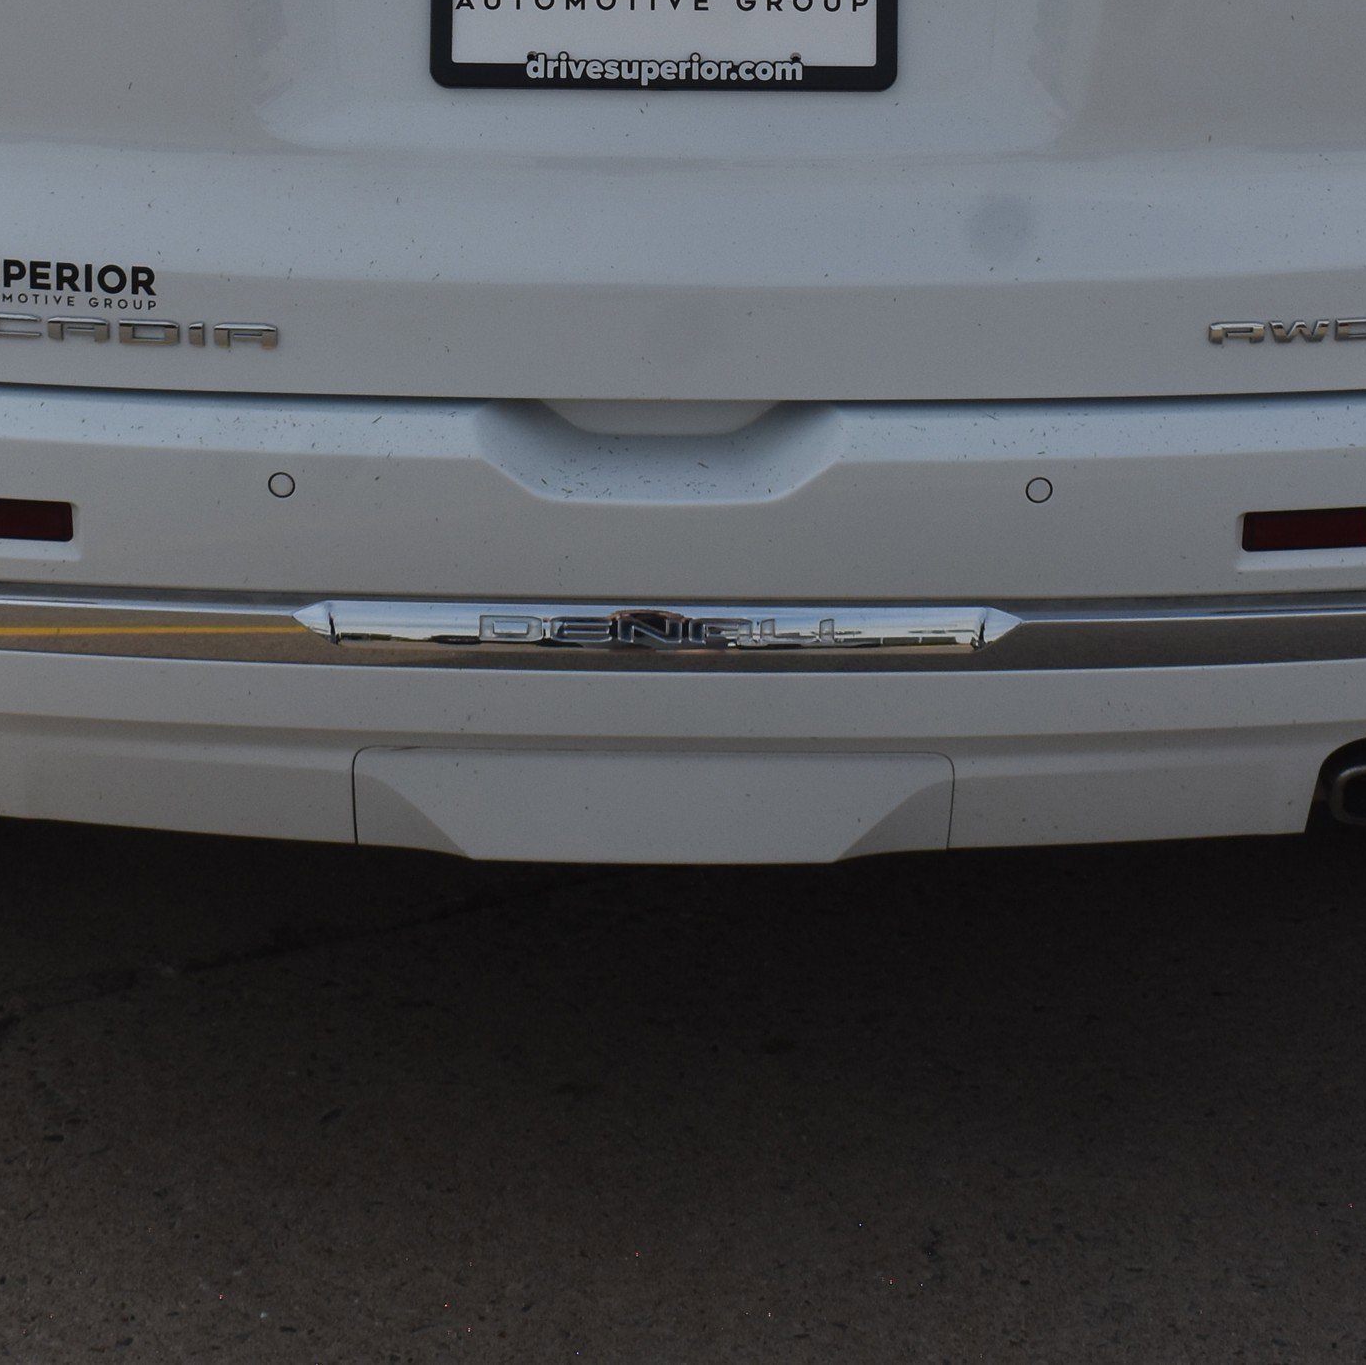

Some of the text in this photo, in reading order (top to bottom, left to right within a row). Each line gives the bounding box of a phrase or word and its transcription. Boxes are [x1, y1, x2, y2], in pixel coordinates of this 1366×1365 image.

[525, 52, 804, 86] drivesuperior.com
[88, 296, 158, 312] GROUP
[479, 611, 835, 647] DENALI
